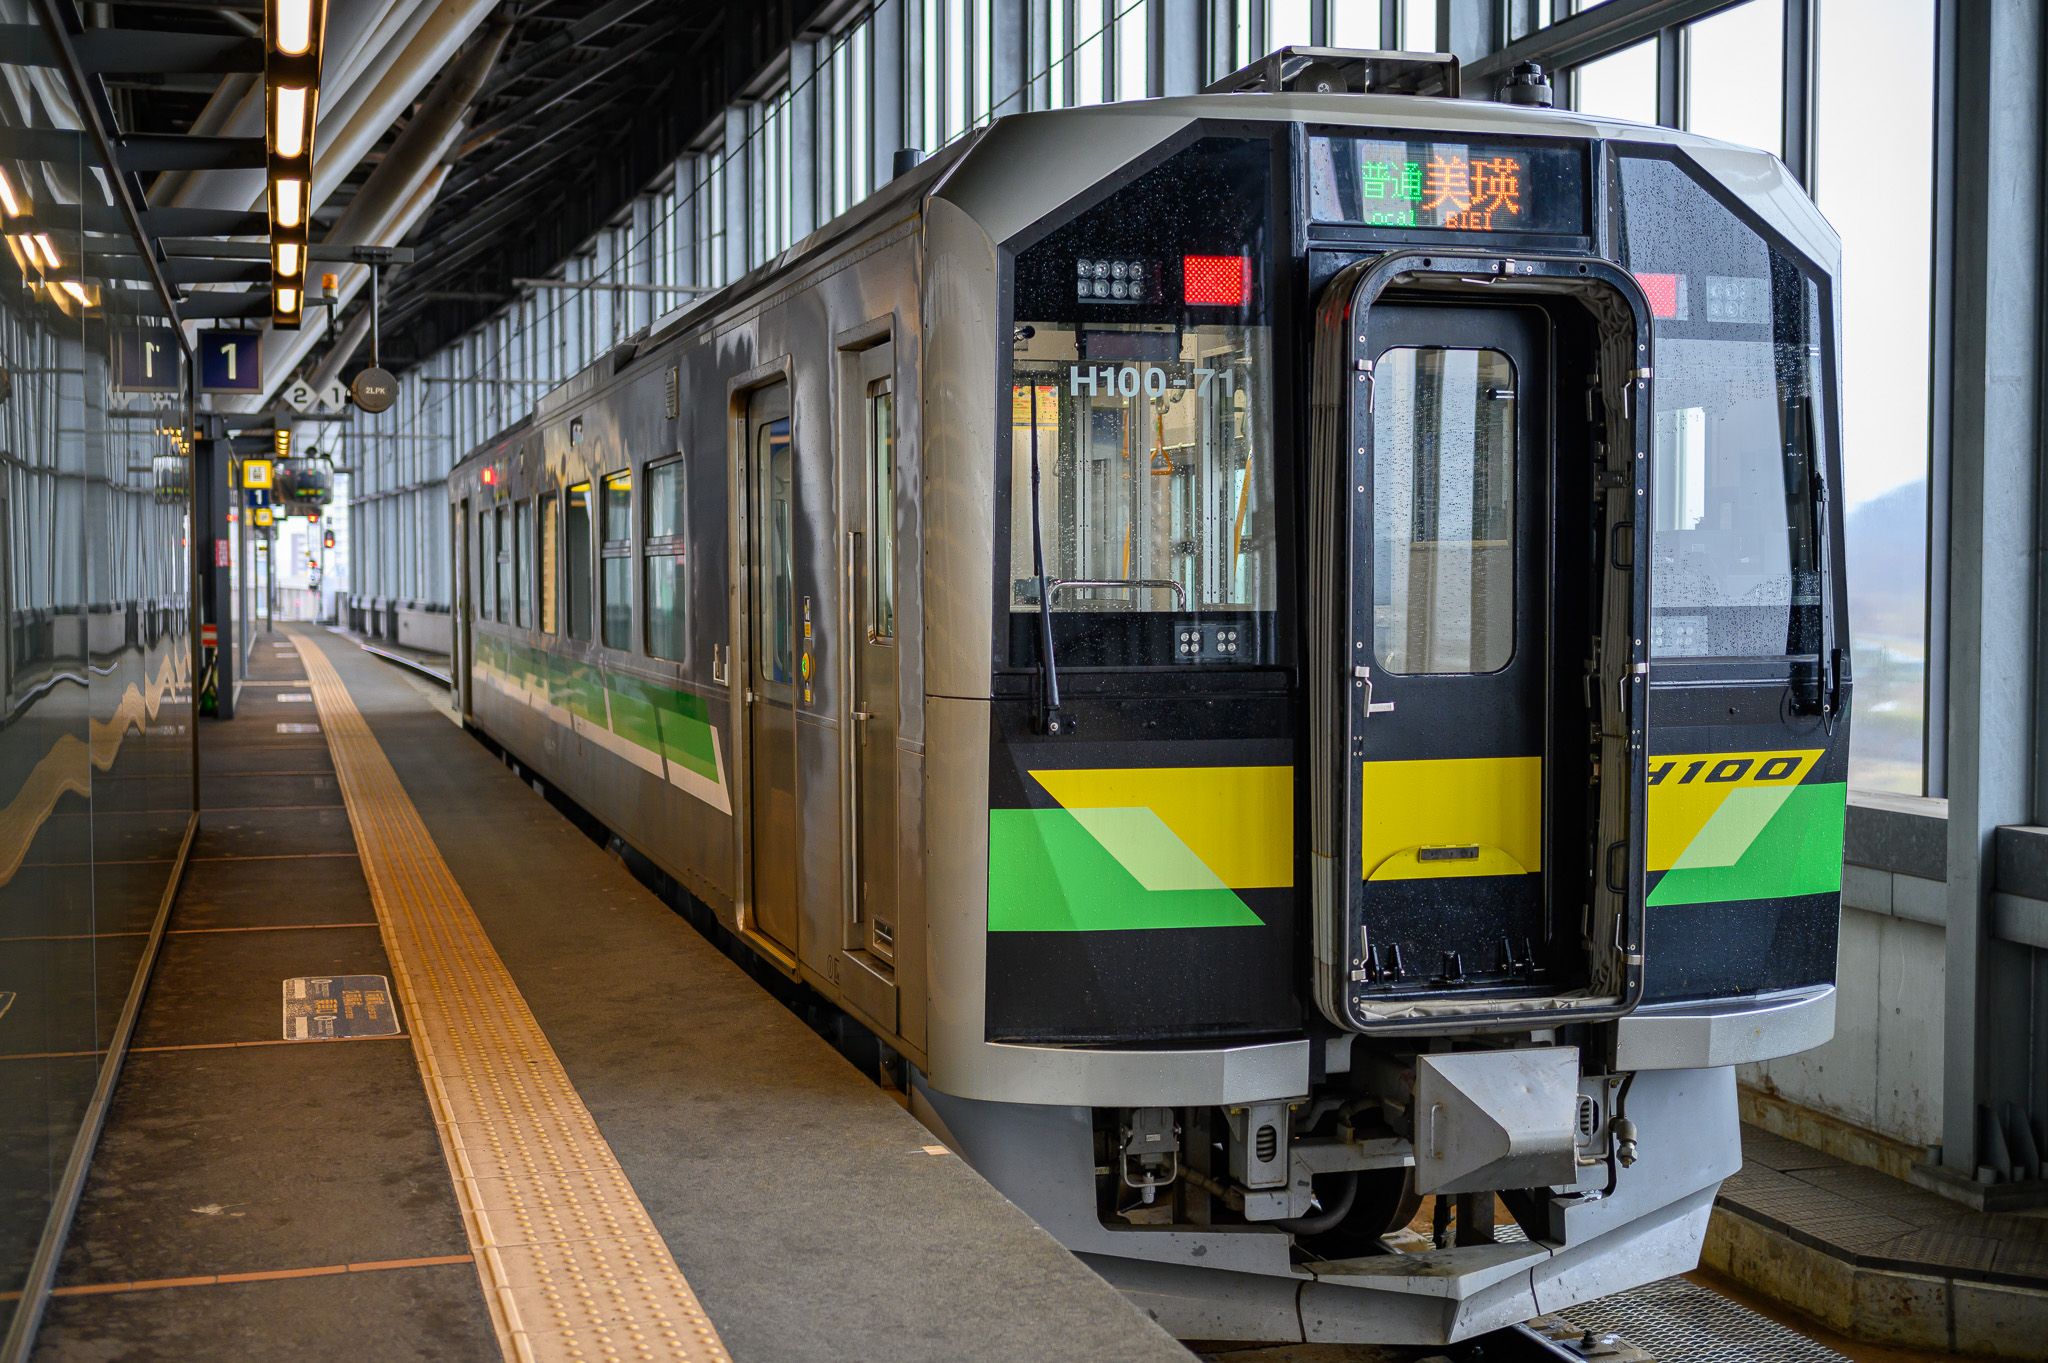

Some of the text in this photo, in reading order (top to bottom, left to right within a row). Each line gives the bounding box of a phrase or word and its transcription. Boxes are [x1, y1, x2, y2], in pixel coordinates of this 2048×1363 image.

[1361, 160, 1423, 201] 普通
[1422, 155, 1521, 215] 美瑛
[220, 342, 237, 381] 1
[293, 387, 307, 404] 2
[331, 387, 340, 404] 1
[1070, 365, 1234, 398] H100-71
[253, 489, 263, 505] 1
